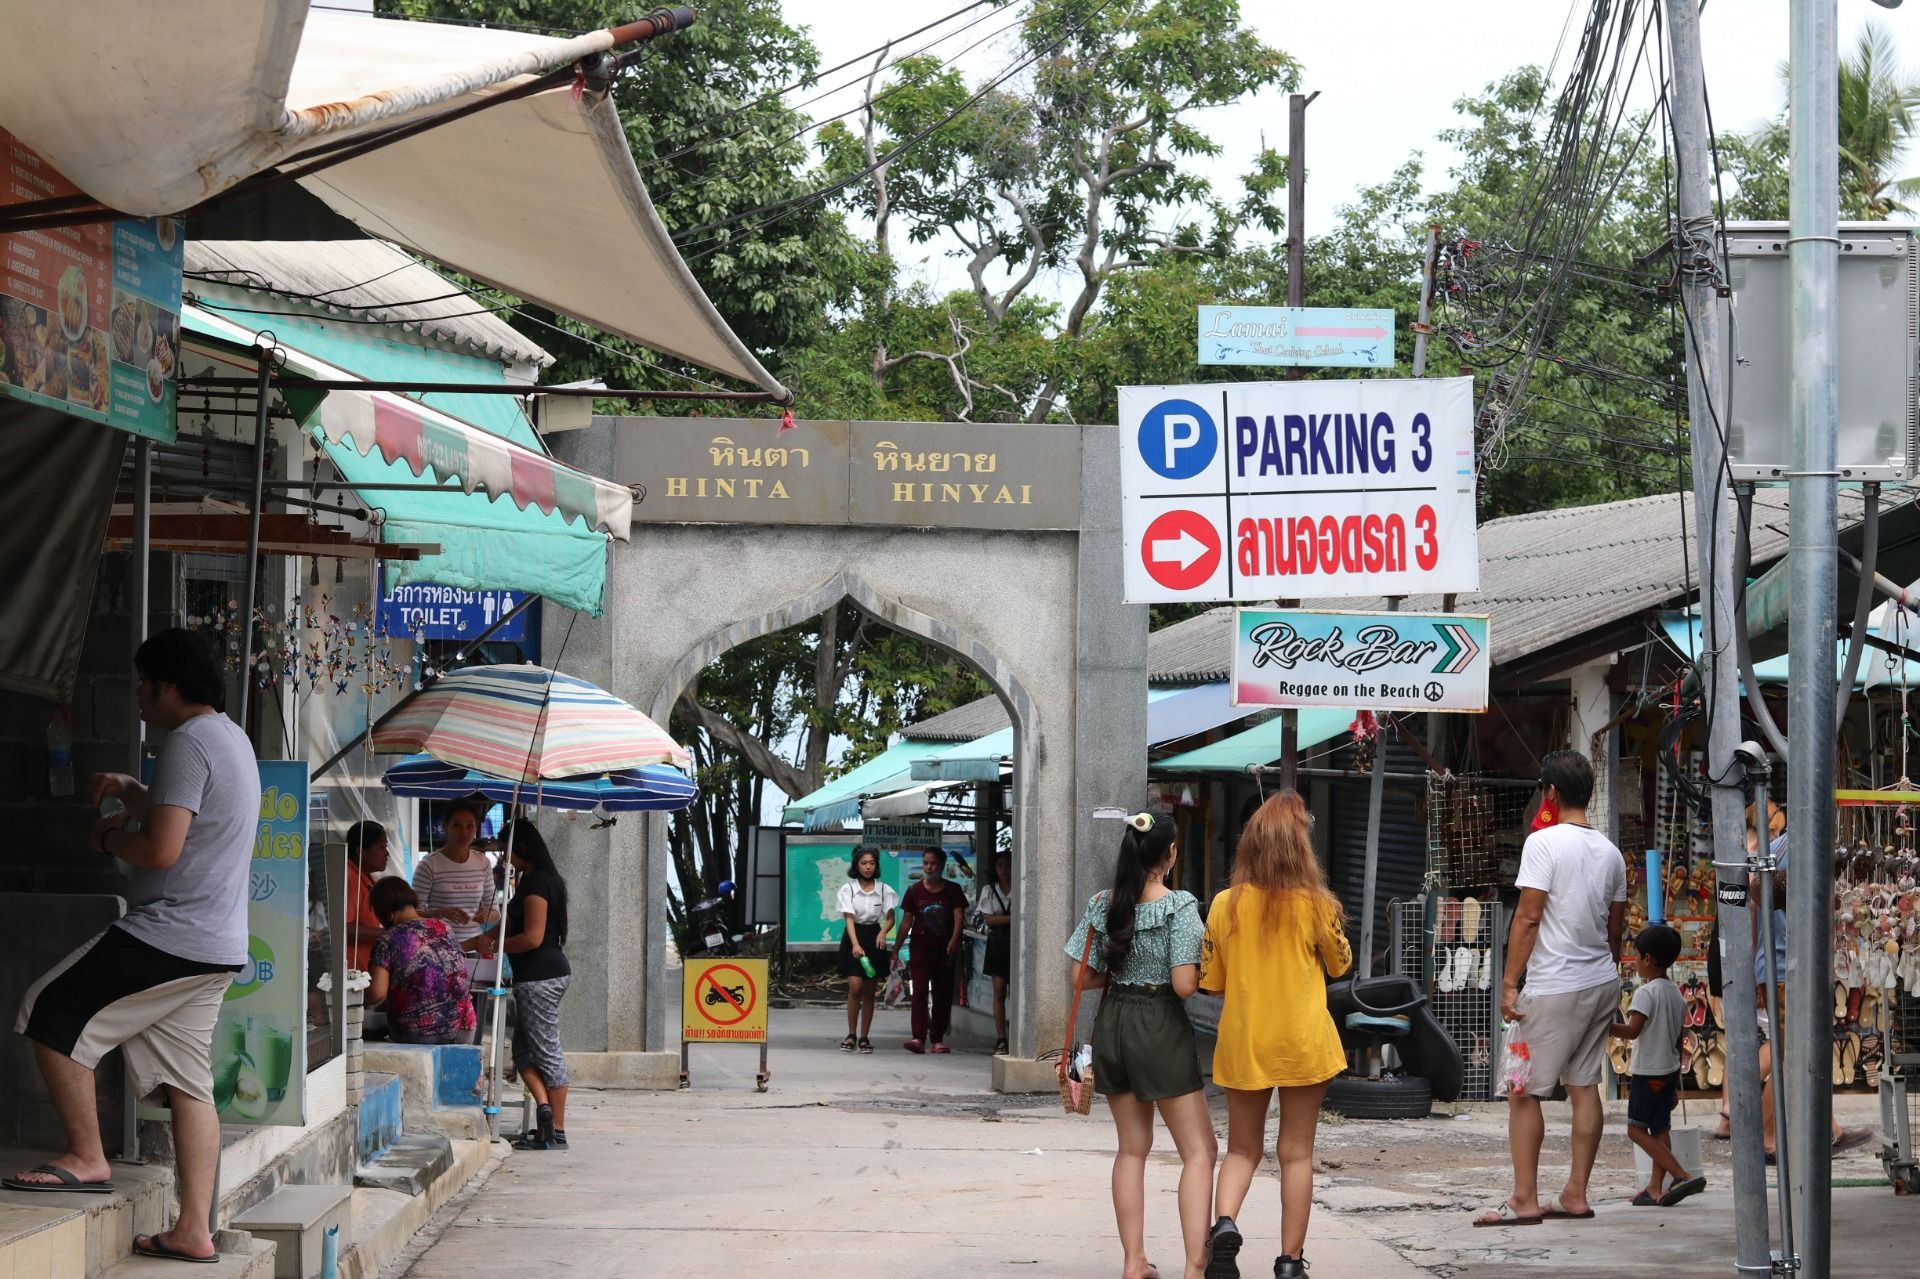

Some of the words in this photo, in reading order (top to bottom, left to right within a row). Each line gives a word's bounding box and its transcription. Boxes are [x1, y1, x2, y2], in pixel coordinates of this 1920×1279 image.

[1204, 311, 1288, 338] Lamai
[708, 436, 809, 468] หินตา
[872, 441, 996, 473] หินยาย
[1236, 412, 1396, 478] PARKING
[1411, 412, 1433, 473] 3
[665, 477, 790, 500] HINTA
[891, 482, 1033, 504] HINYAI
[1237, 512, 1407, 577] ลานจอดรถ
[1415, 504, 1438, 571] 3
[400, 607, 462, 626] TOILET
[1249, 622, 1345, 669] Rock
[1343, 624, 1436, 674] Bar
[1279, 680, 1328, 699] Reggae
[1332, 685, 1350, 697] on
[1353, 681, 1376, 698] the
[1380, 682, 1420, 699] Beach
[1719, 890, 1746, 900] THURB
